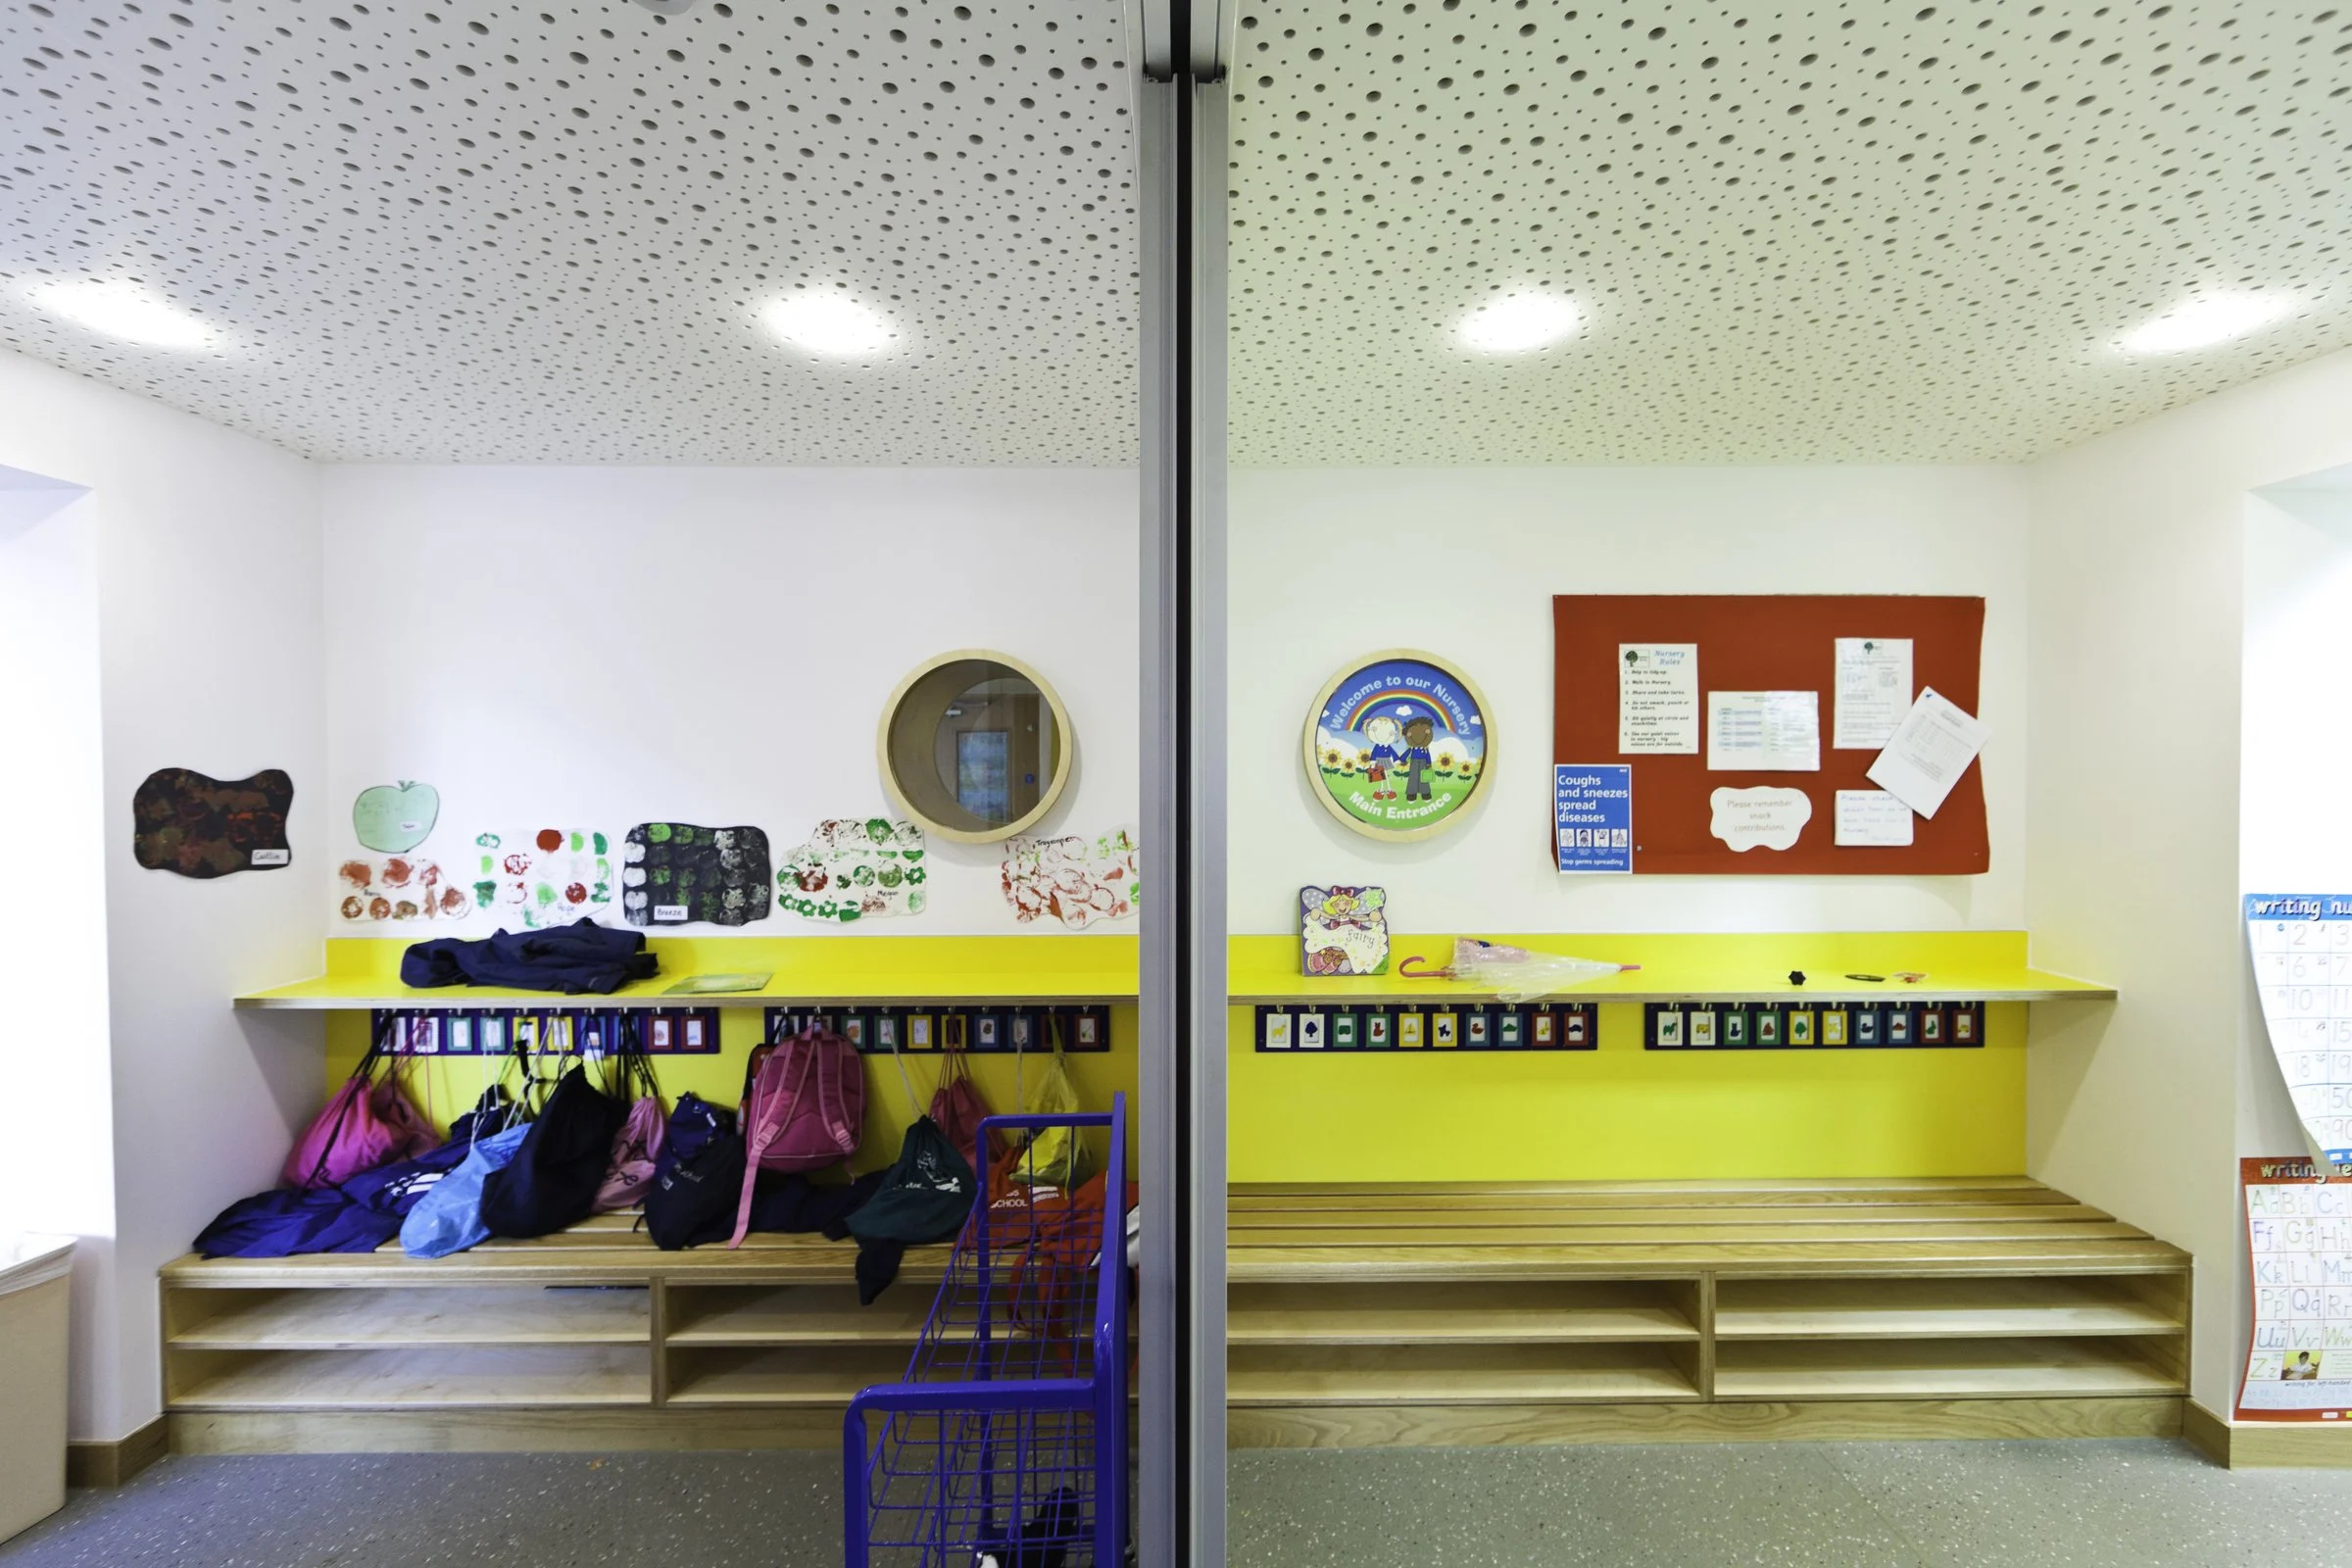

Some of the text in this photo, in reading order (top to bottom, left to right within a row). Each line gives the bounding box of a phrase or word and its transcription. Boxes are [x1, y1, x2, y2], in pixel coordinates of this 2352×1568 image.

[1654, 650, 1686, 659] Nursery
[1330, 675, 1471, 736] Welcome to our Nursery
[1558, 775, 1601, 788] Coughs
[1558, 788, 1628, 799] and sneezes
[1349, 790, 1452, 819] Main Entrance
[1559, 800, 1596, 812] spread
[1727, 800, 1792, 808] Please remember
[1559, 811, 1605, 823] diseases
[1748, 811, 1772, 820] snack
[657, 907, 683, 916] Breeze
[2254, 899, 2322, 921] writing
[1346, 928, 1375, 949] Fairy
[2293, 923, 2308, 946] 2
[2335, 923, 2350, 946] 3
[2293, 956, 2350, 978] 6 7
[2292, 988, 2313, 1010] 10
